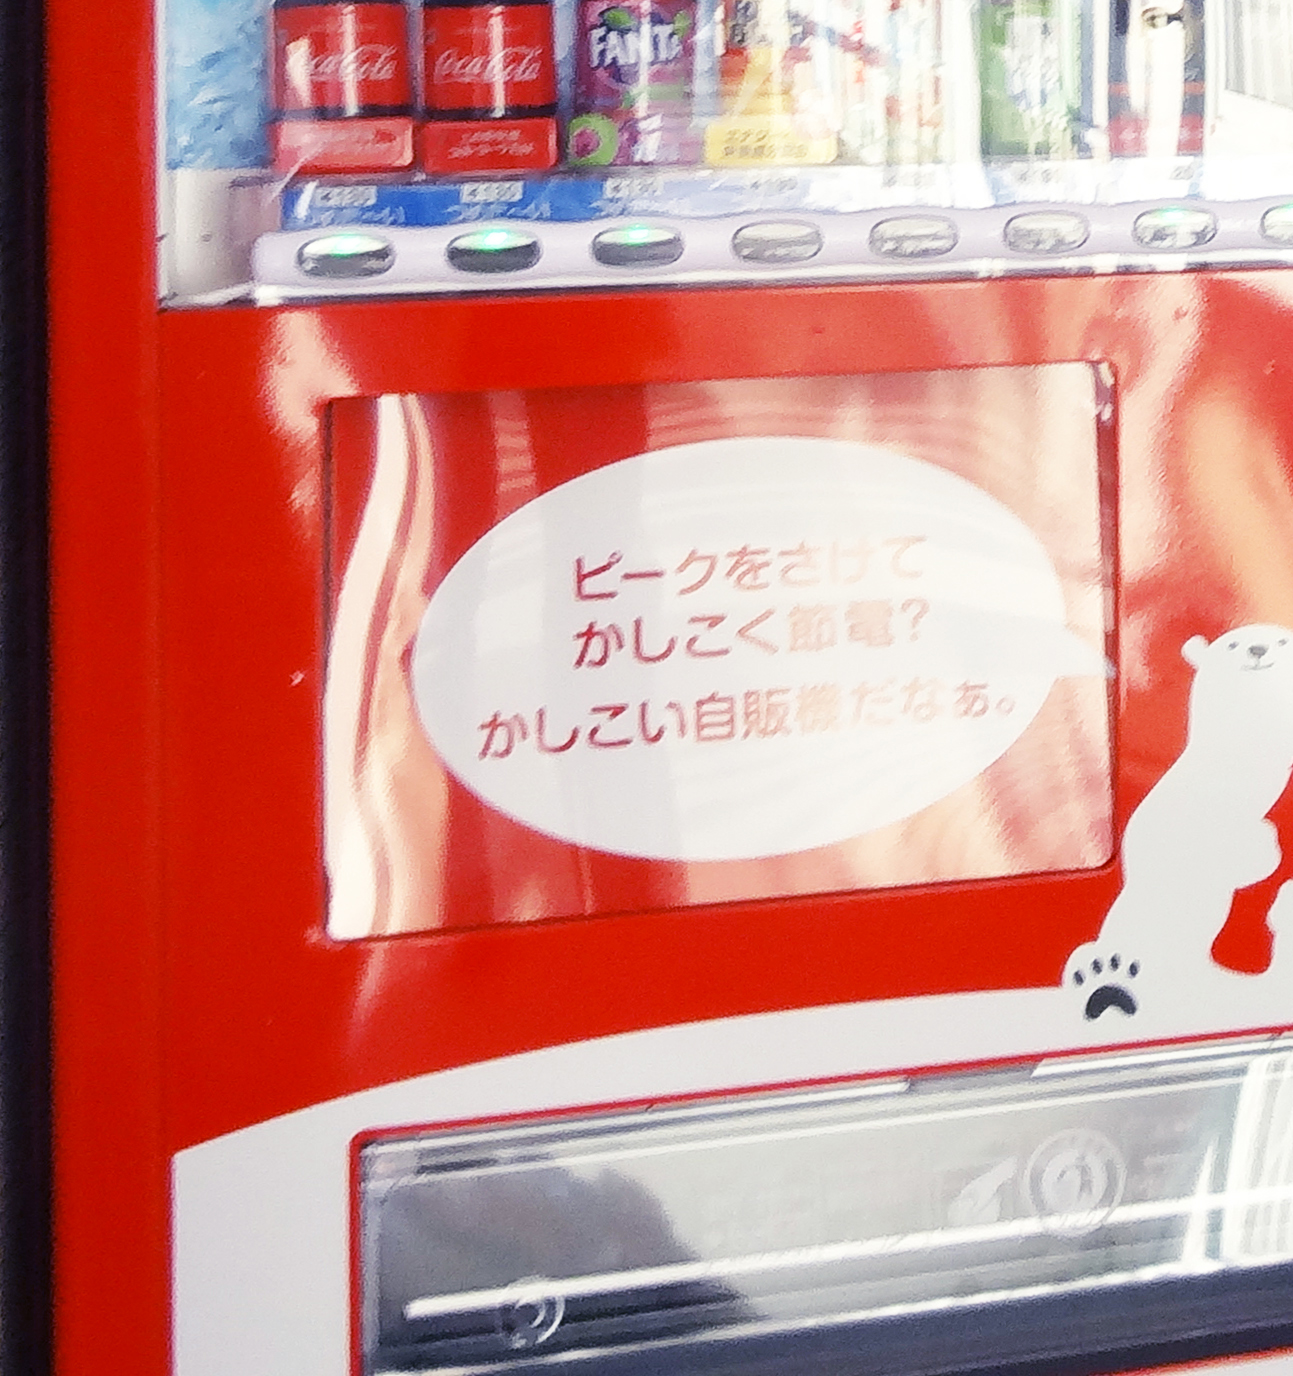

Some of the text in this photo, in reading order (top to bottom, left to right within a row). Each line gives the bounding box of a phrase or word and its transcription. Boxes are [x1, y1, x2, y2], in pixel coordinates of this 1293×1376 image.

[571, 534, 930, 605] ピークをさけて
[571, 597, 932, 672] かしこく節電?
[475, 676, 1018, 765] かしこい自販機だなぁ。
